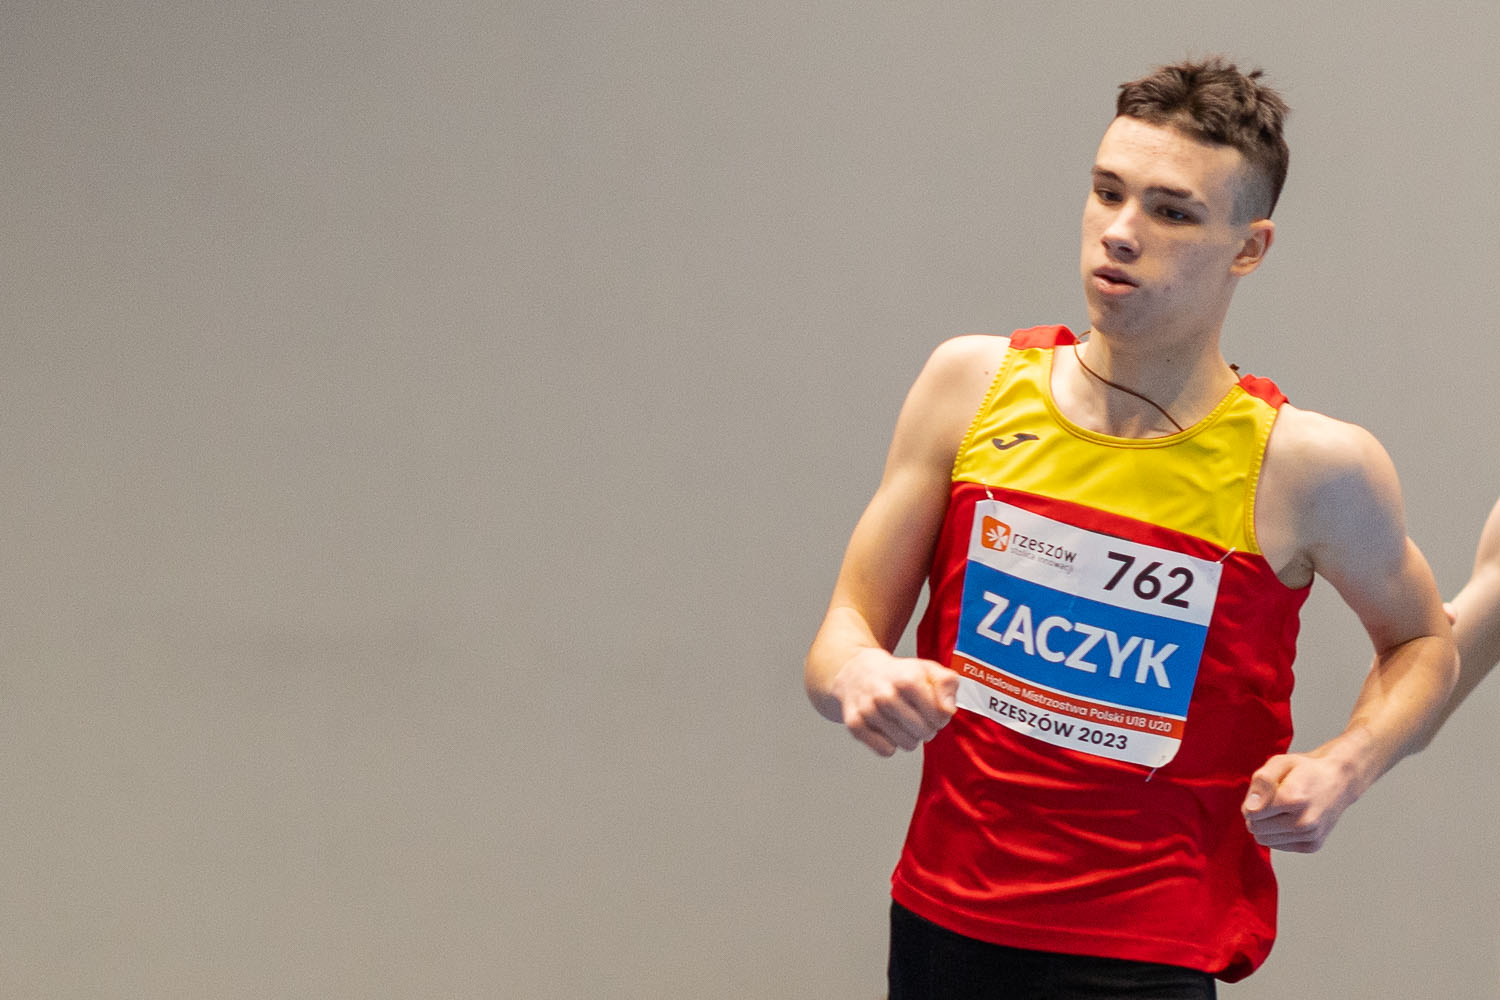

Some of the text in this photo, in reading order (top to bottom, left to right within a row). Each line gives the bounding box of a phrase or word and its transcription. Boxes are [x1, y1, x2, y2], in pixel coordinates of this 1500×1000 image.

[1012, 533, 1077, 563] rzeszów
[1103, 551, 1194, 609] 762
[976, 590, 1180, 689] ZACZYK
[985, 673, 1021, 695] Halowe
[1021, 687, 1088, 716] Mistrzostwa
[1089, 708, 1124, 723] Polski
[1126, 715, 1147, 728] U18
[1148, 719, 1172, 732] U20
[989, 696, 1128, 750] RZESZÓW 2023
